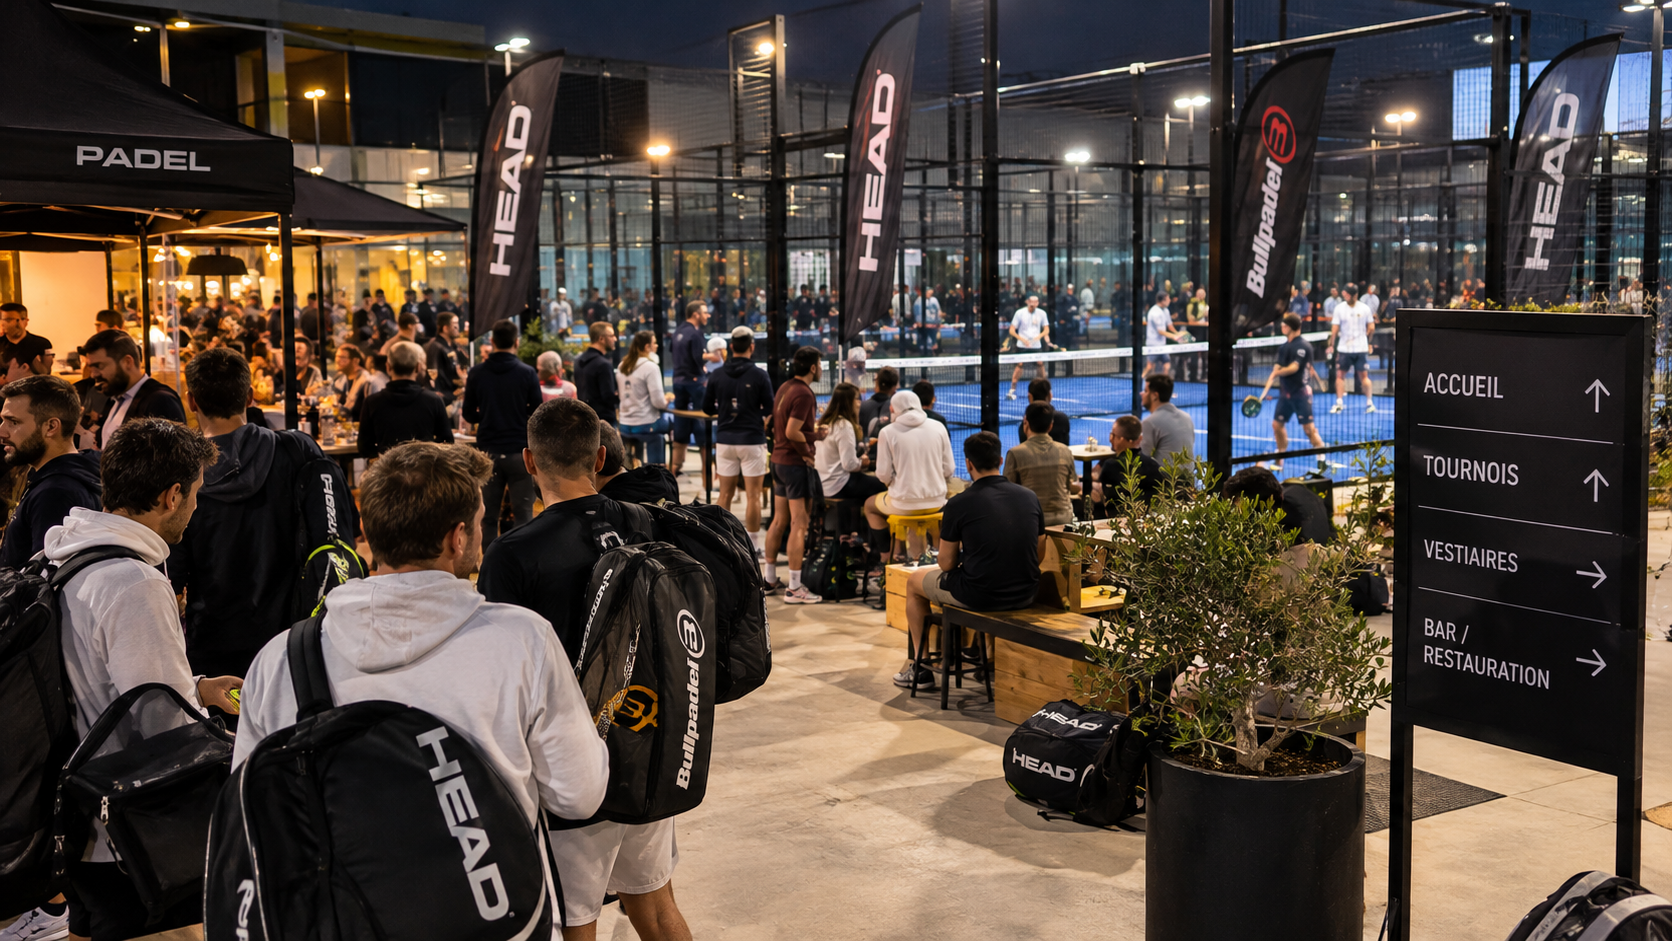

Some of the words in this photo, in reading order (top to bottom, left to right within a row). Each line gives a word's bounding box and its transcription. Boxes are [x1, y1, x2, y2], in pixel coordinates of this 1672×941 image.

[76, 145, 211, 172] PADEL
[858, 73, 896, 272] HEAD
[1524, 92, 1580, 271] HEAD
[489, 104, 532, 277] HEAD
[1246, 156, 1283, 299] Bullpadel
[1423, 372, 1504, 399] ACCUEIL
[1423, 454, 1519, 486] TOURNOIS
[1423, 538, 1519, 573] VESTIAIRES
[1423, 617, 1456, 642] BAR
[1423, 644, 1550, 690] RESTAURATION
[676, 657, 700, 791] Bullpadel
[1012, 747, 1076, 783] HEAD
[415, 725, 510, 921] HEAD
